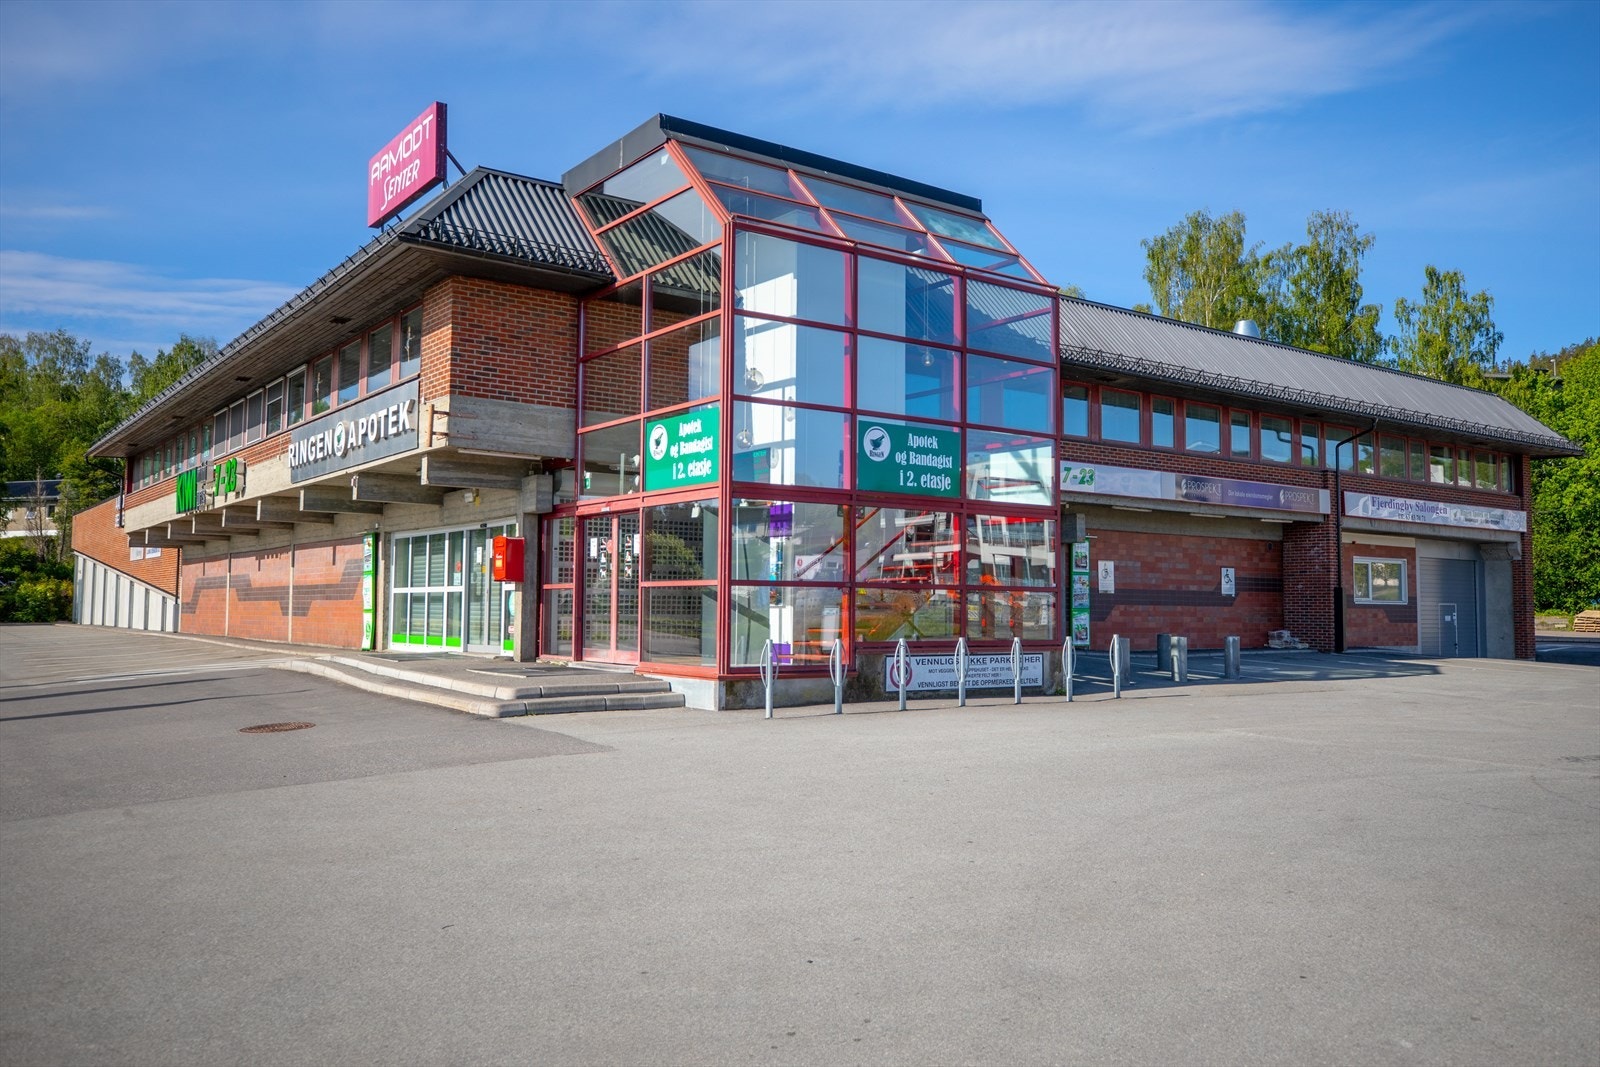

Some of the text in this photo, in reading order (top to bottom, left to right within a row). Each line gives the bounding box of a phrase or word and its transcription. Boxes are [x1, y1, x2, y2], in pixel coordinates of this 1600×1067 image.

[288, 399, 411, 468] RINGEN APOTEK
[678, 418, 703, 438] Apotek
[669, 435, 714, 459] og Bandagist
[907, 432, 939, 450] Apotek
[672, 457, 713, 480] i 2. etasje
[895, 450, 953, 470] og Bandagist
[899, 469, 952, 492] i 2. etasje
[1187, 480, 1222, 497] PROSPEKT
[1371, 496, 1414, 512] Fjerdingby
[1415, 501, 1448, 516] Salongen
[915, 657, 960, 666] VENNLIGS
[969, 657, 988, 665] KKE
[917, 680, 949, 688] VENNLIGST
[949, 679, 971, 687] BENTT
[971, 678, 980, 686] DE
